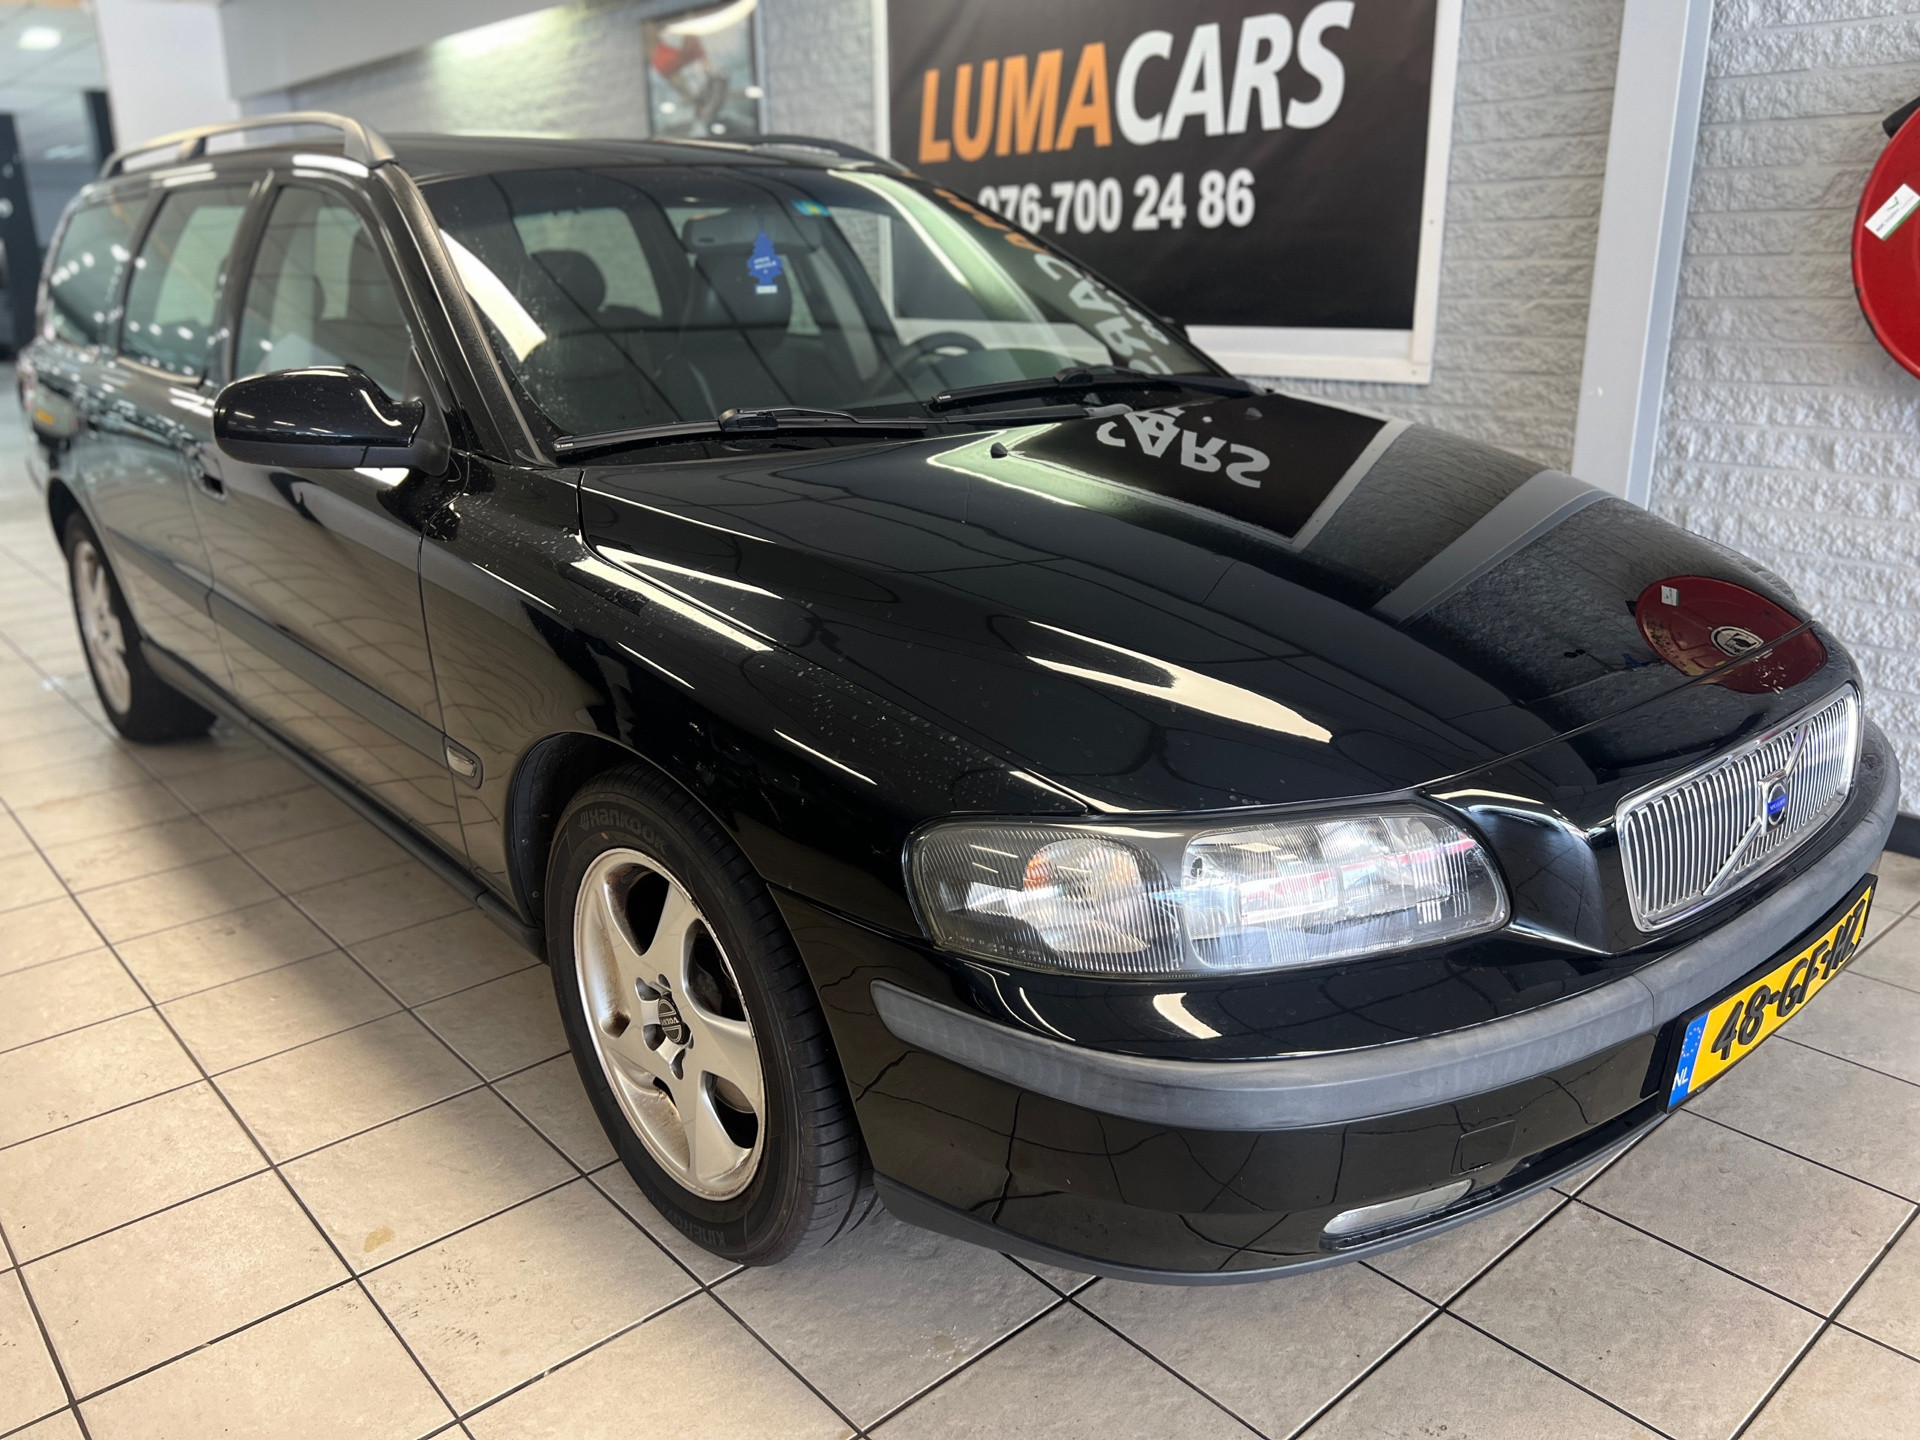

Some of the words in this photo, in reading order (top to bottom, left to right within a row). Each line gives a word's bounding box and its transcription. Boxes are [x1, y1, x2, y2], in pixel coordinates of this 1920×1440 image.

[1132, 172, 1185, 230] 24
[1199, 168, 1255, 227] 86
[1672, 1066, 1689, 1091] NL
